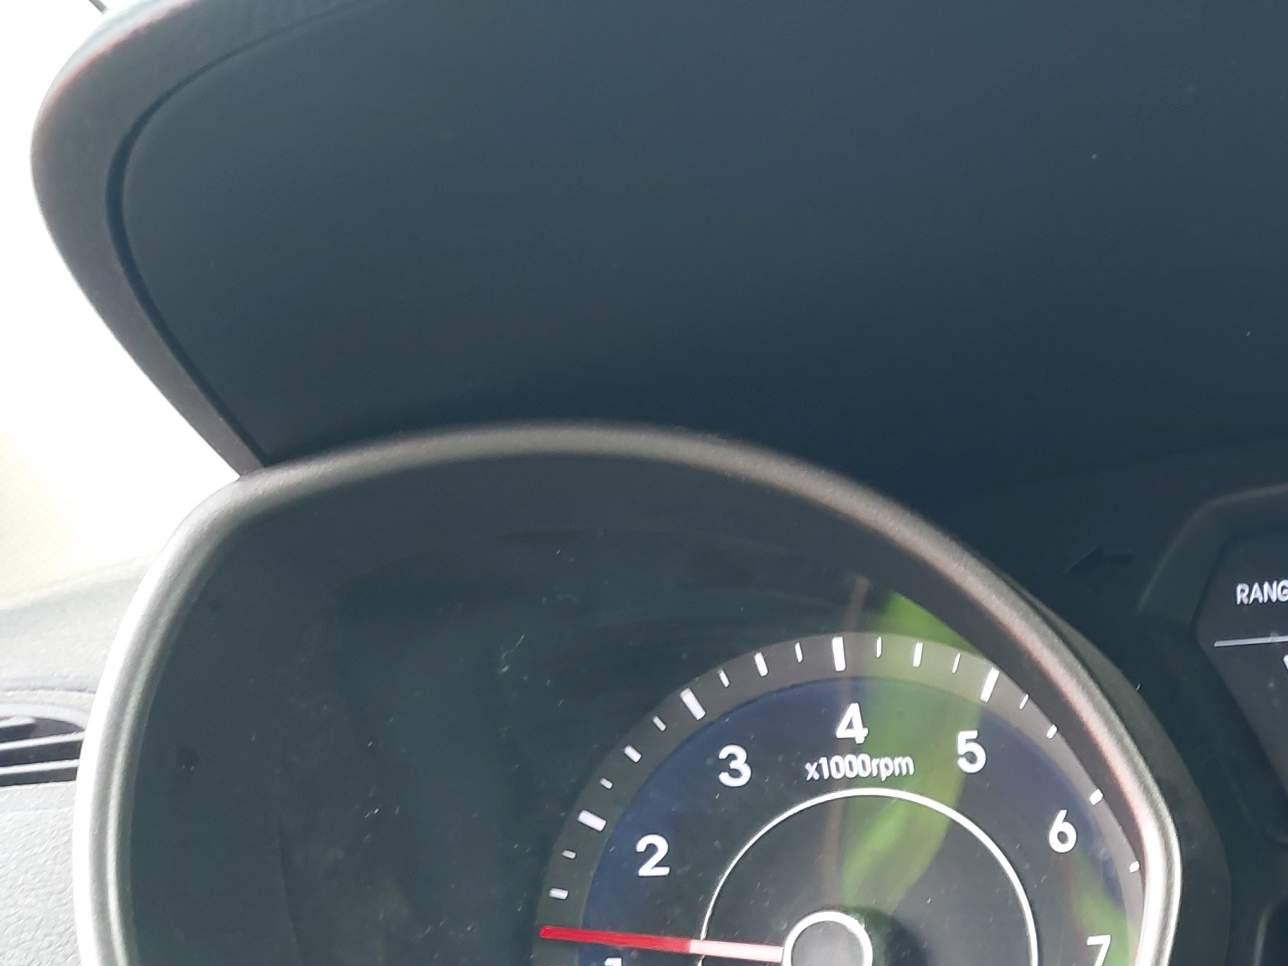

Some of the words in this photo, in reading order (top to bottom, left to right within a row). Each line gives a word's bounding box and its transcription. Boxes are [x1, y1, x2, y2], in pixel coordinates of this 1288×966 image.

[835, 702, 868, 744] 4
[718, 745, 752, 788] 3
[805, 754, 914, 780] x1000rpm
[956, 730, 986, 773] 5
[1048, 810, 1078, 853] 6
[635, 834, 671, 877] 2
